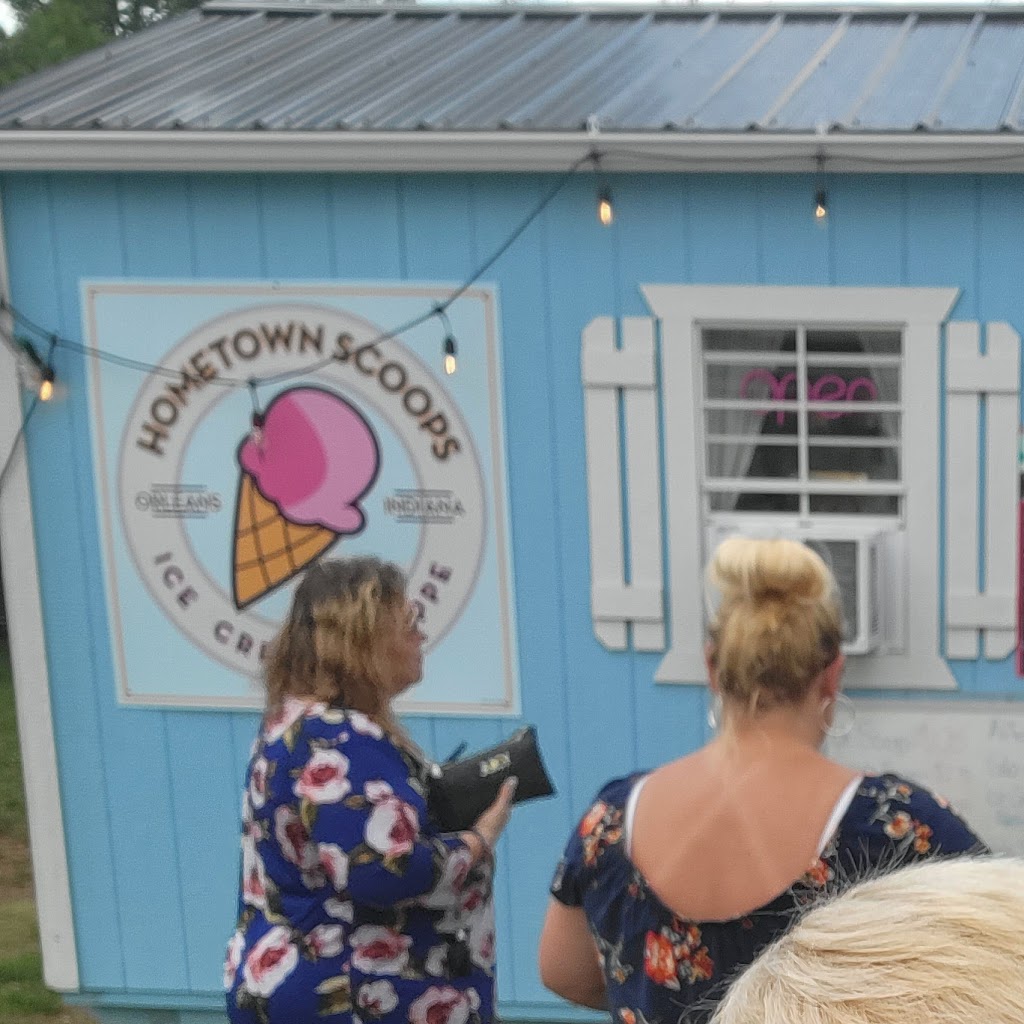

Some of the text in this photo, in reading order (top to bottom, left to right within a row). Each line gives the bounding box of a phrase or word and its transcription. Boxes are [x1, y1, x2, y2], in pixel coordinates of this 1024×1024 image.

[137, 321, 461, 462] HOMETOWN SCOOPS
[154, 551, 198, 610] ICE
